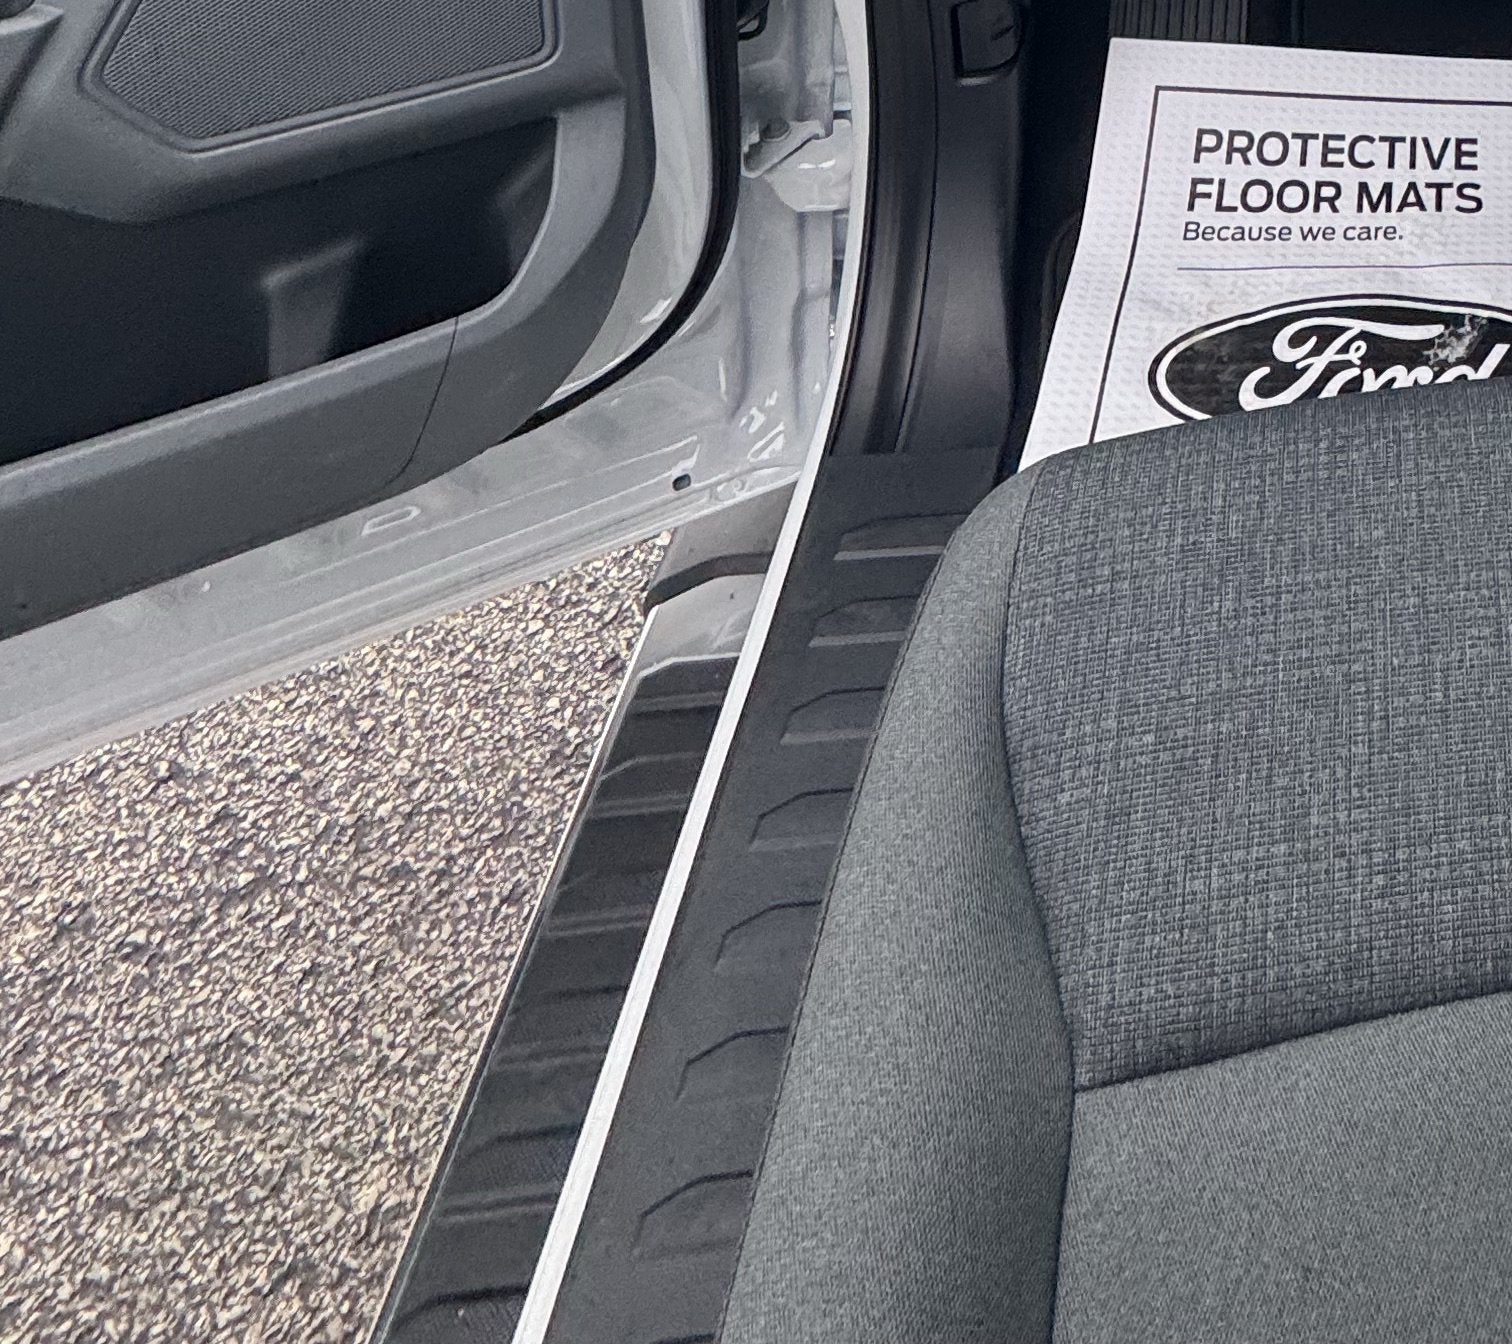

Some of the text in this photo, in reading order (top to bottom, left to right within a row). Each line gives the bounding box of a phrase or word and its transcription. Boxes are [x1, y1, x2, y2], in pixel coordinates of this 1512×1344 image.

[1192, 127, 1480, 172] PROTECTIVE
[1186, 176, 1484, 214] FLOOR MATS
[1182, 220, 1404, 242] Because we care.
